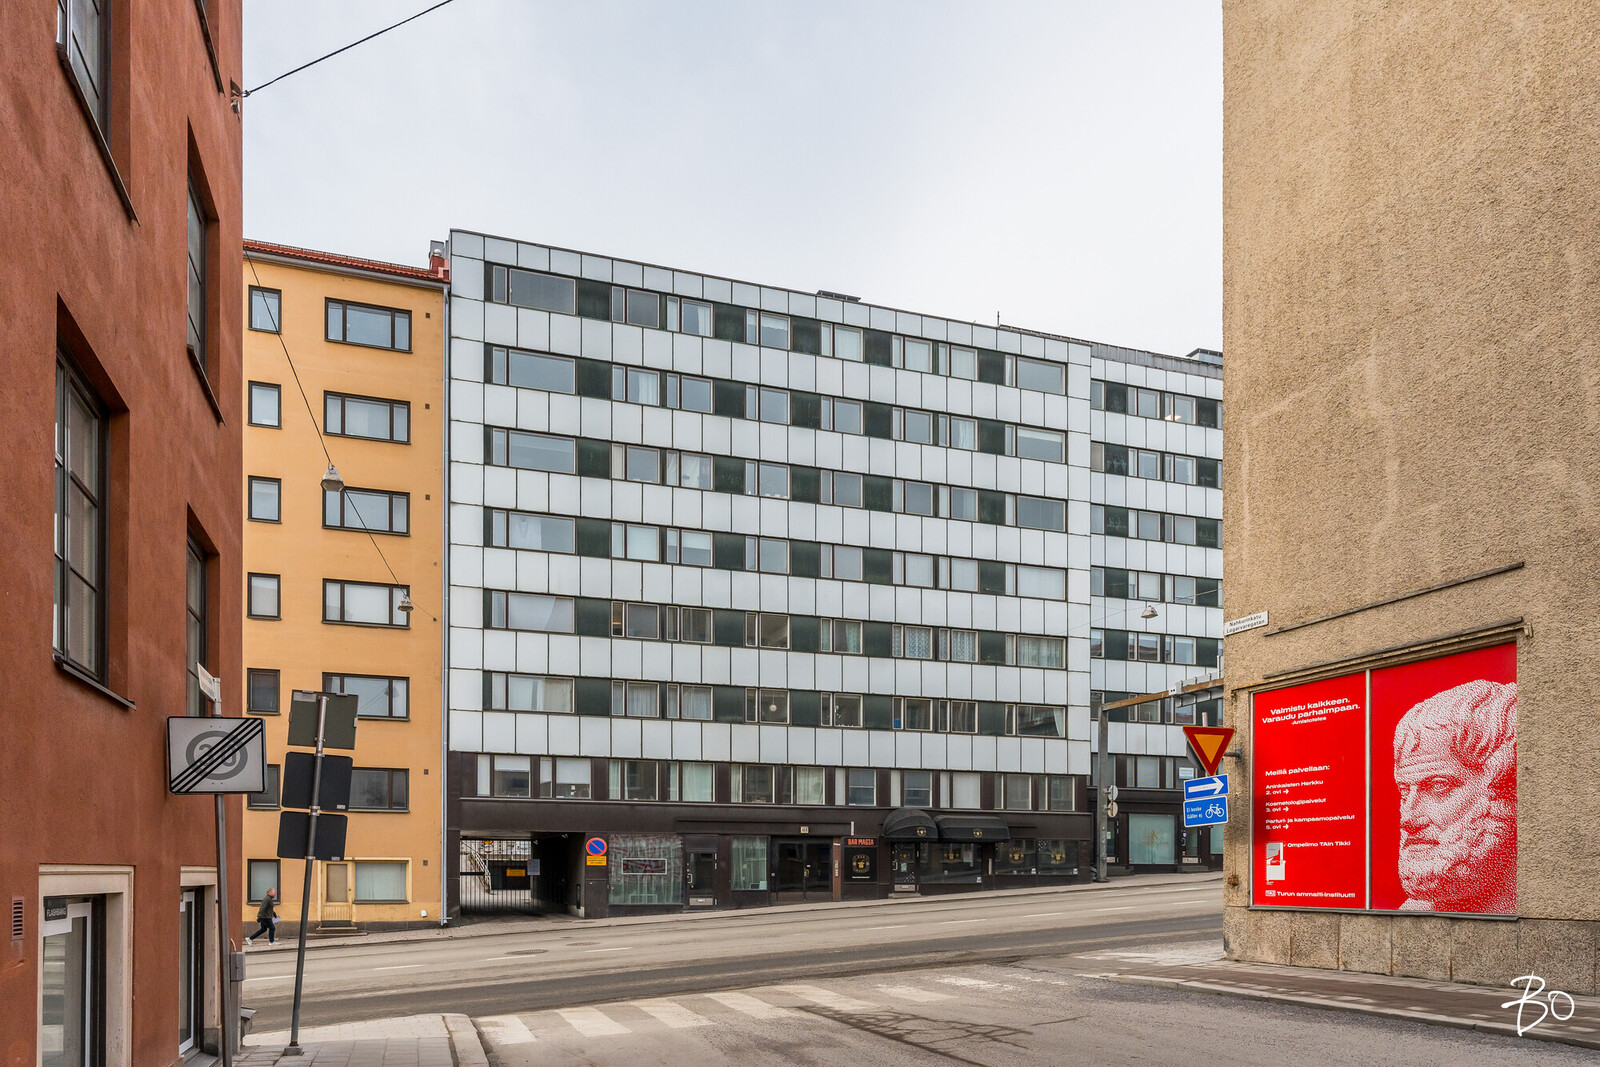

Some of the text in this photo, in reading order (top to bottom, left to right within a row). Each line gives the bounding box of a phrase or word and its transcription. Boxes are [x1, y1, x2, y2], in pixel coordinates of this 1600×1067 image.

[1229, 614, 1262, 626] Nahkurinkatu
[1270, 697, 1350, 715] Valmistu kaikkeen.
[1262, 703, 1360, 723] Varaudu parhaimpaan.
[1265, 765, 1330, 776] Meillä palvellaan:
[1265, 798, 1326, 807] Kosmetologipalvelut
